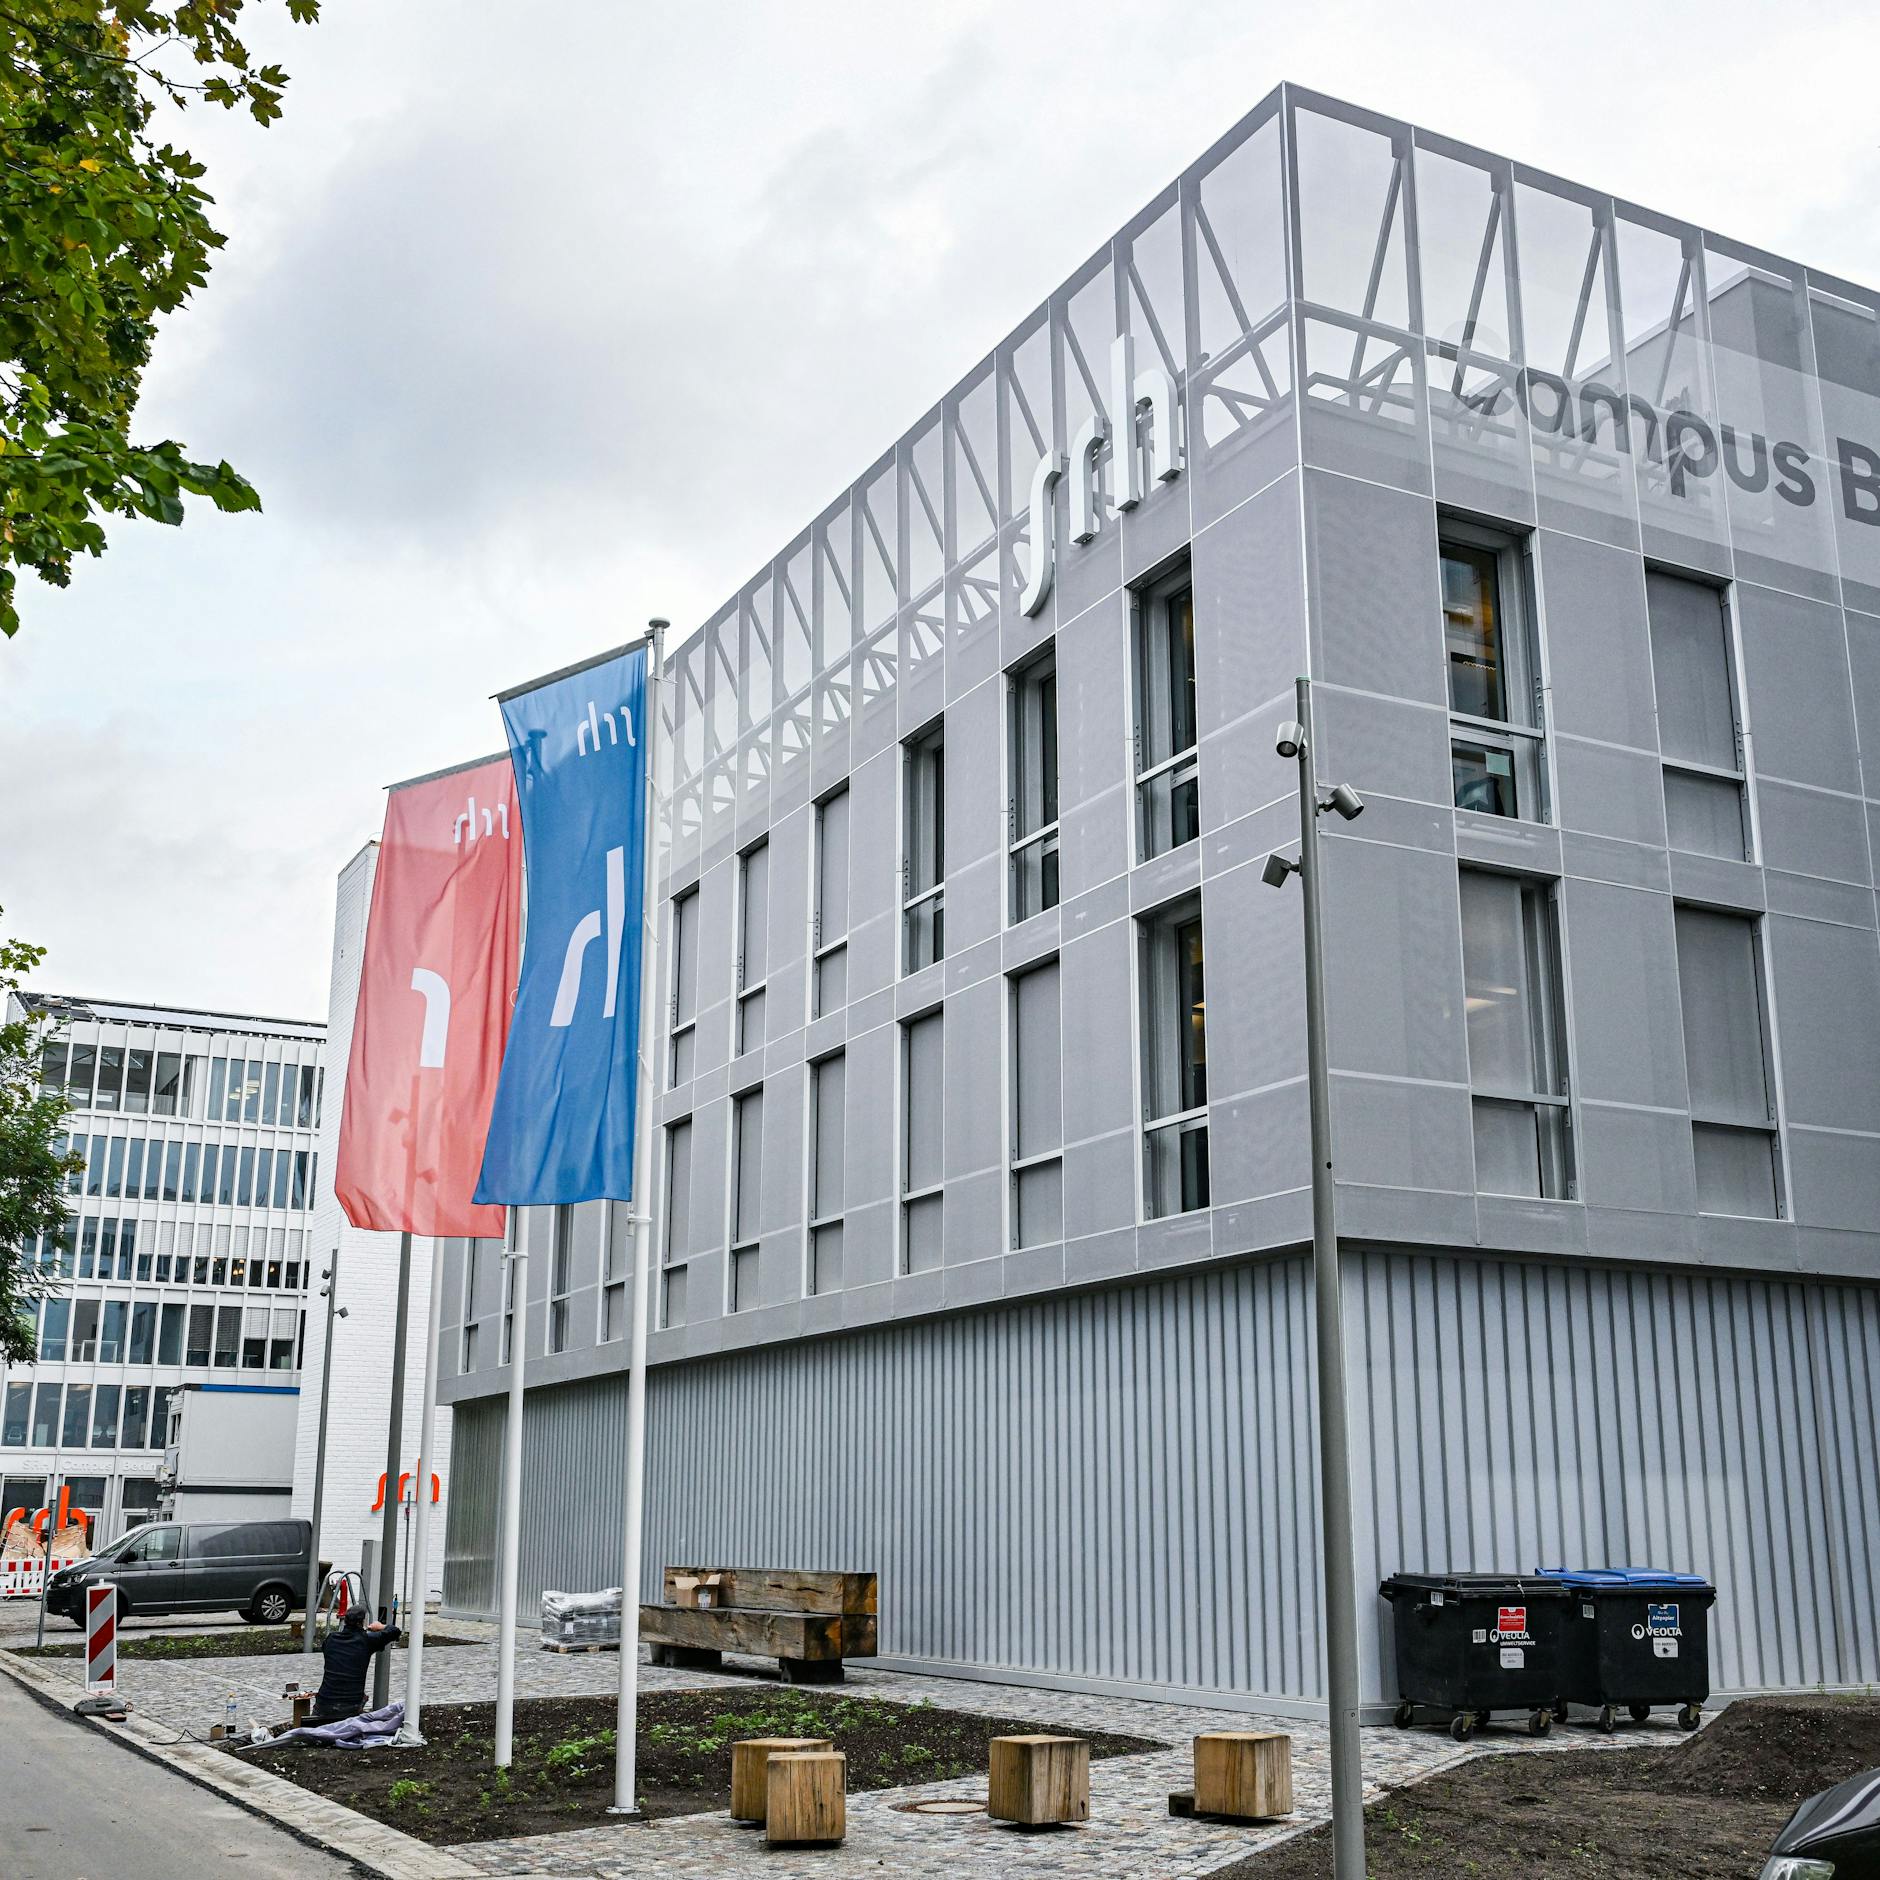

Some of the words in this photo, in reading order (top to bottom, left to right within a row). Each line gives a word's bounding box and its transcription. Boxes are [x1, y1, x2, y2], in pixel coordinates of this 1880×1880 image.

[1440, 320, 1816, 507] Campus
[62, 1460, 113, 1472] Campus
[122, 1460, 157, 1472] Berlin
[1500, 1631, 1531, 1640] VEOLIA
[1646, 1627, 1682, 1637] VEOLIA
